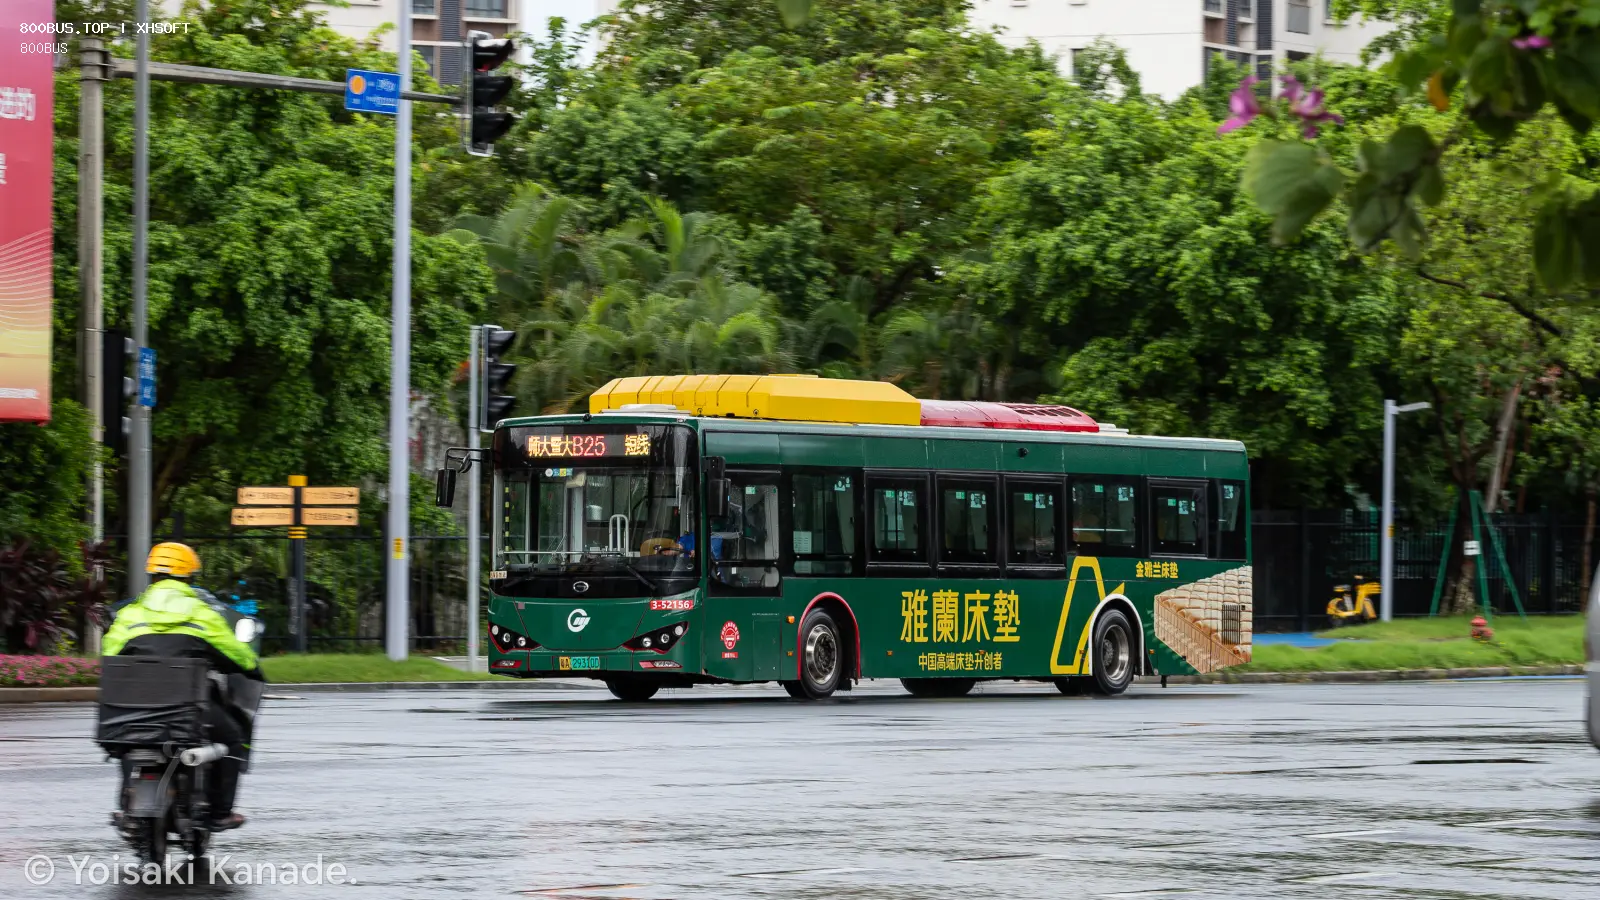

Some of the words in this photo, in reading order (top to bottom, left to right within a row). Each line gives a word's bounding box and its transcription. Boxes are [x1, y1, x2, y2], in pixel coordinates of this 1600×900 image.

[1136, 561, 1178, 578] 金雅兰床垫
[652, 600, 690, 609] 3-52156
[900, 589, 1021, 643] 雅蘭床墊
[918, 652, 1003, 671] 中国高端床垫开创者
